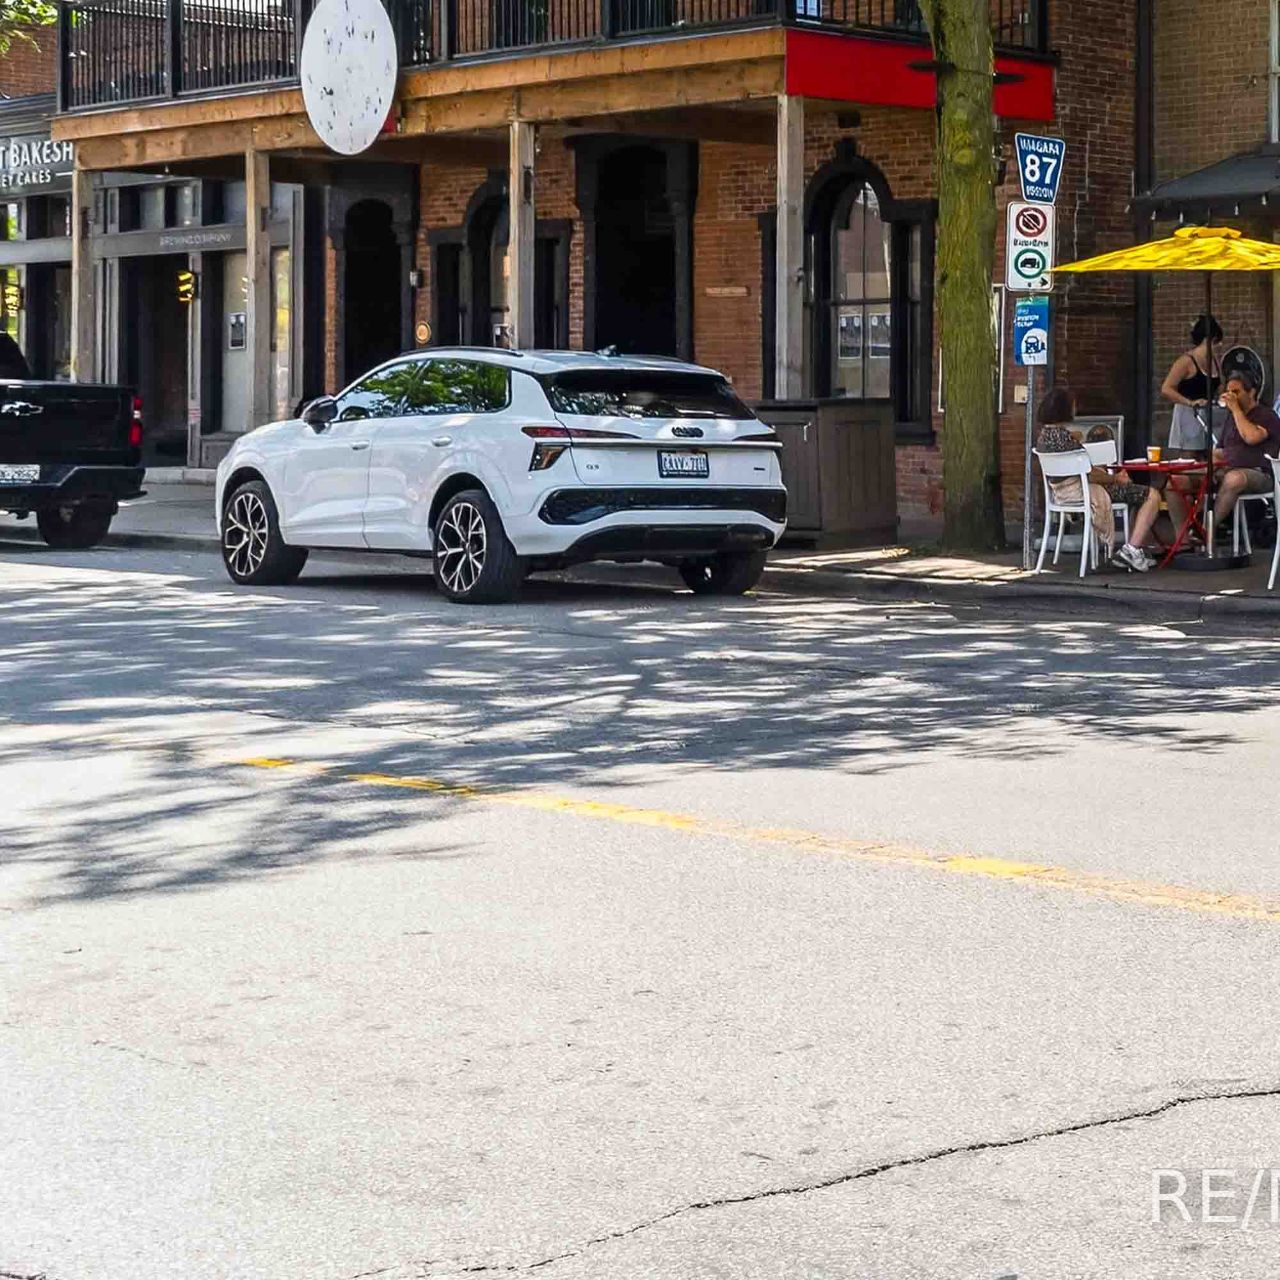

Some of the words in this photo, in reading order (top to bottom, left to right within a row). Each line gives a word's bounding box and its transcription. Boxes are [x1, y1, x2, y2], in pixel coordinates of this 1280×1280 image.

[10, 139, 74, 167] BAKESH
[1019, 137, 1060, 155] NIAGARA
[17, 169, 52, 186] CAKES
[1025, 154, 1057, 184] 87
